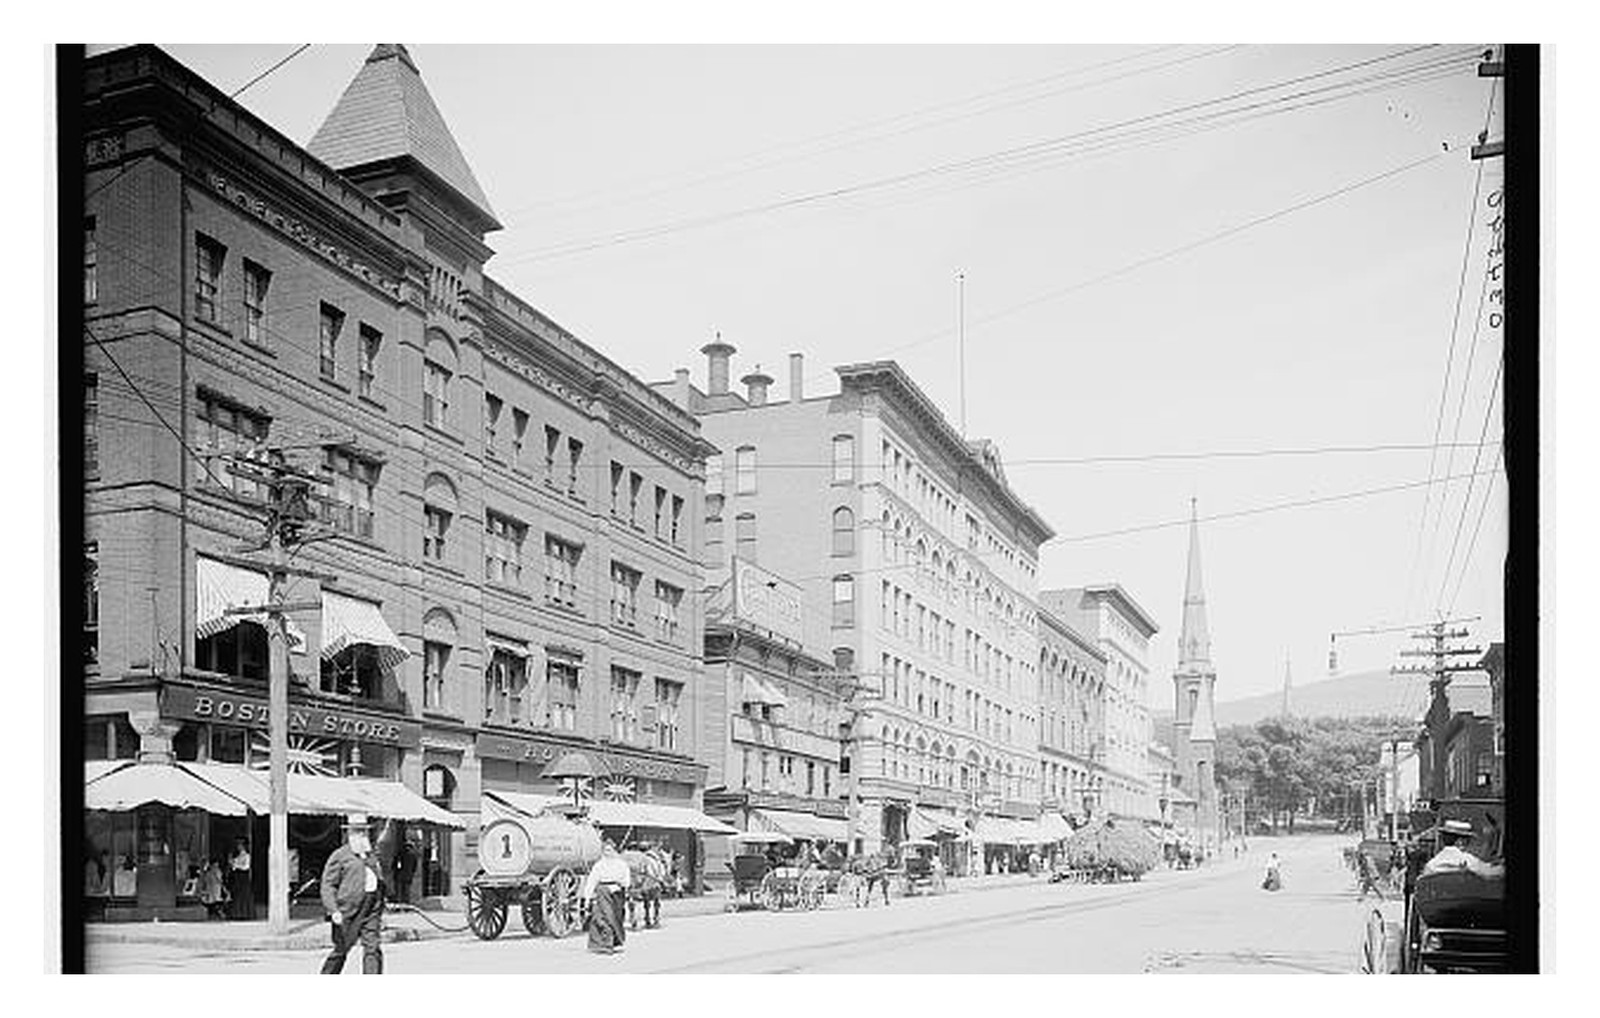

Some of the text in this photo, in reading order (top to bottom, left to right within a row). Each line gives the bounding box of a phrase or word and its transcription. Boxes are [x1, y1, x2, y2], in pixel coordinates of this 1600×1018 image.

[194, 697, 401, 741] BOSTN STORE
[501, 833, 512, 859] 1
